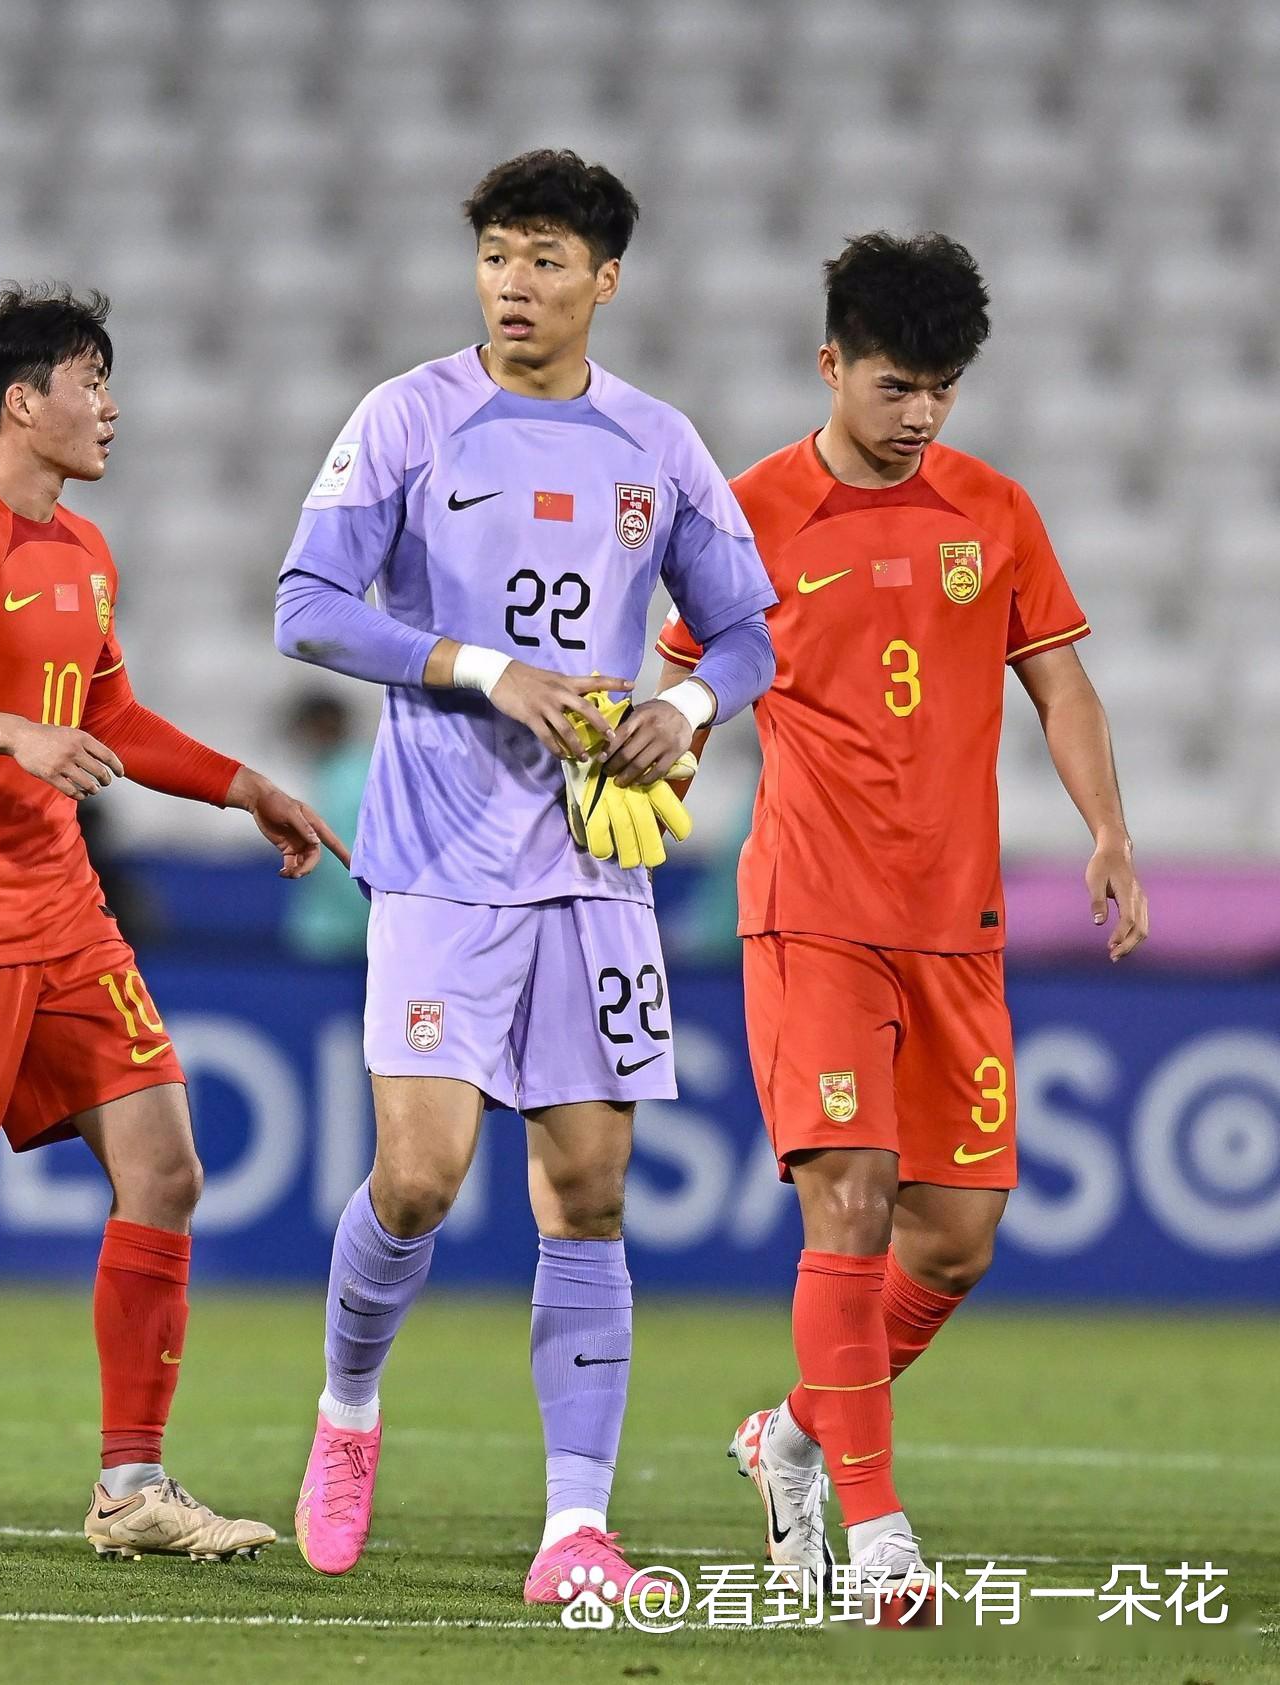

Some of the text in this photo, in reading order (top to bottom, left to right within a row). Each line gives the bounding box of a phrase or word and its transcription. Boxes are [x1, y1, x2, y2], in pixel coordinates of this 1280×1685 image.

[620, 488, 651, 503] CFA
[943, 546, 976, 558] CFA
[505, 569, 590, 650] 22
[42, 662, 82, 729] 10
[882, 640, 921, 717] 3
[98, 969, 164, 1038] 10
[411, 1004, 440, 1015] CFA
[598, 964, 670, 1044] 22
[822, 1075, 851, 1086] CFA
[971, 1056, 1007, 1133] 3
